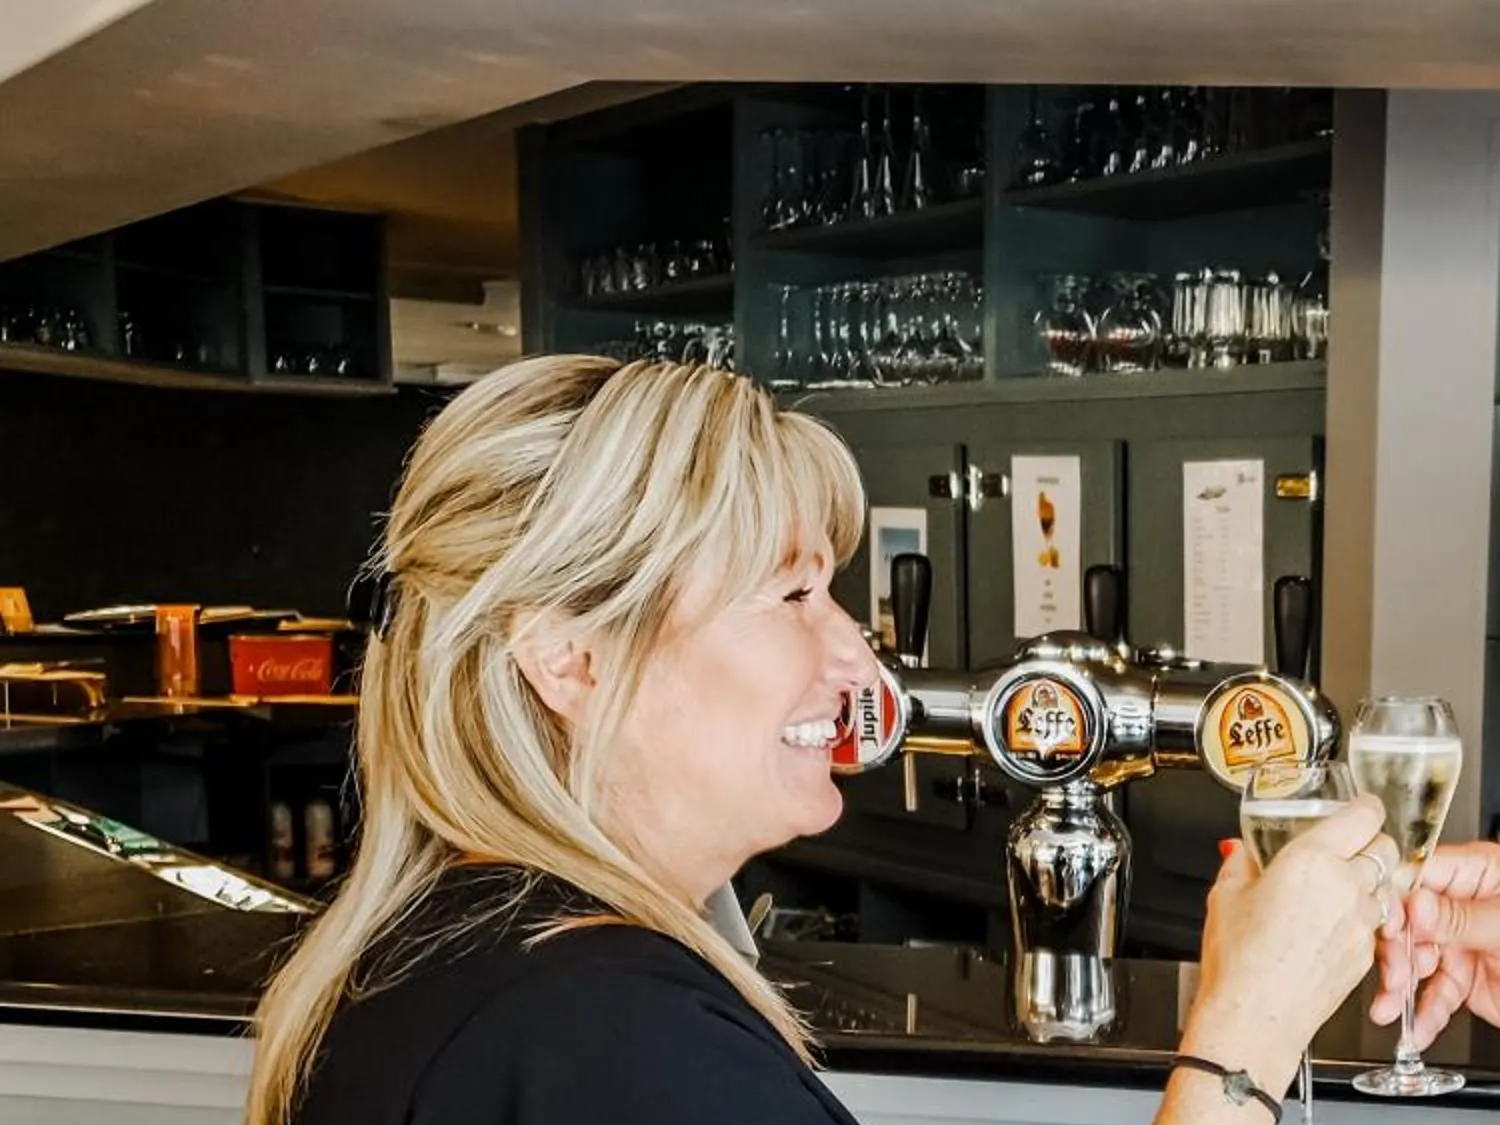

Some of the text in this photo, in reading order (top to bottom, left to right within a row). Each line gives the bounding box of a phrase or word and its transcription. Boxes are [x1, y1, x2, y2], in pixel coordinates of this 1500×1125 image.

[859, 687, 879, 748] Jupile
[1015, 707, 1077, 739] Leffe
[1229, 719, 1285, 748] Leffe
